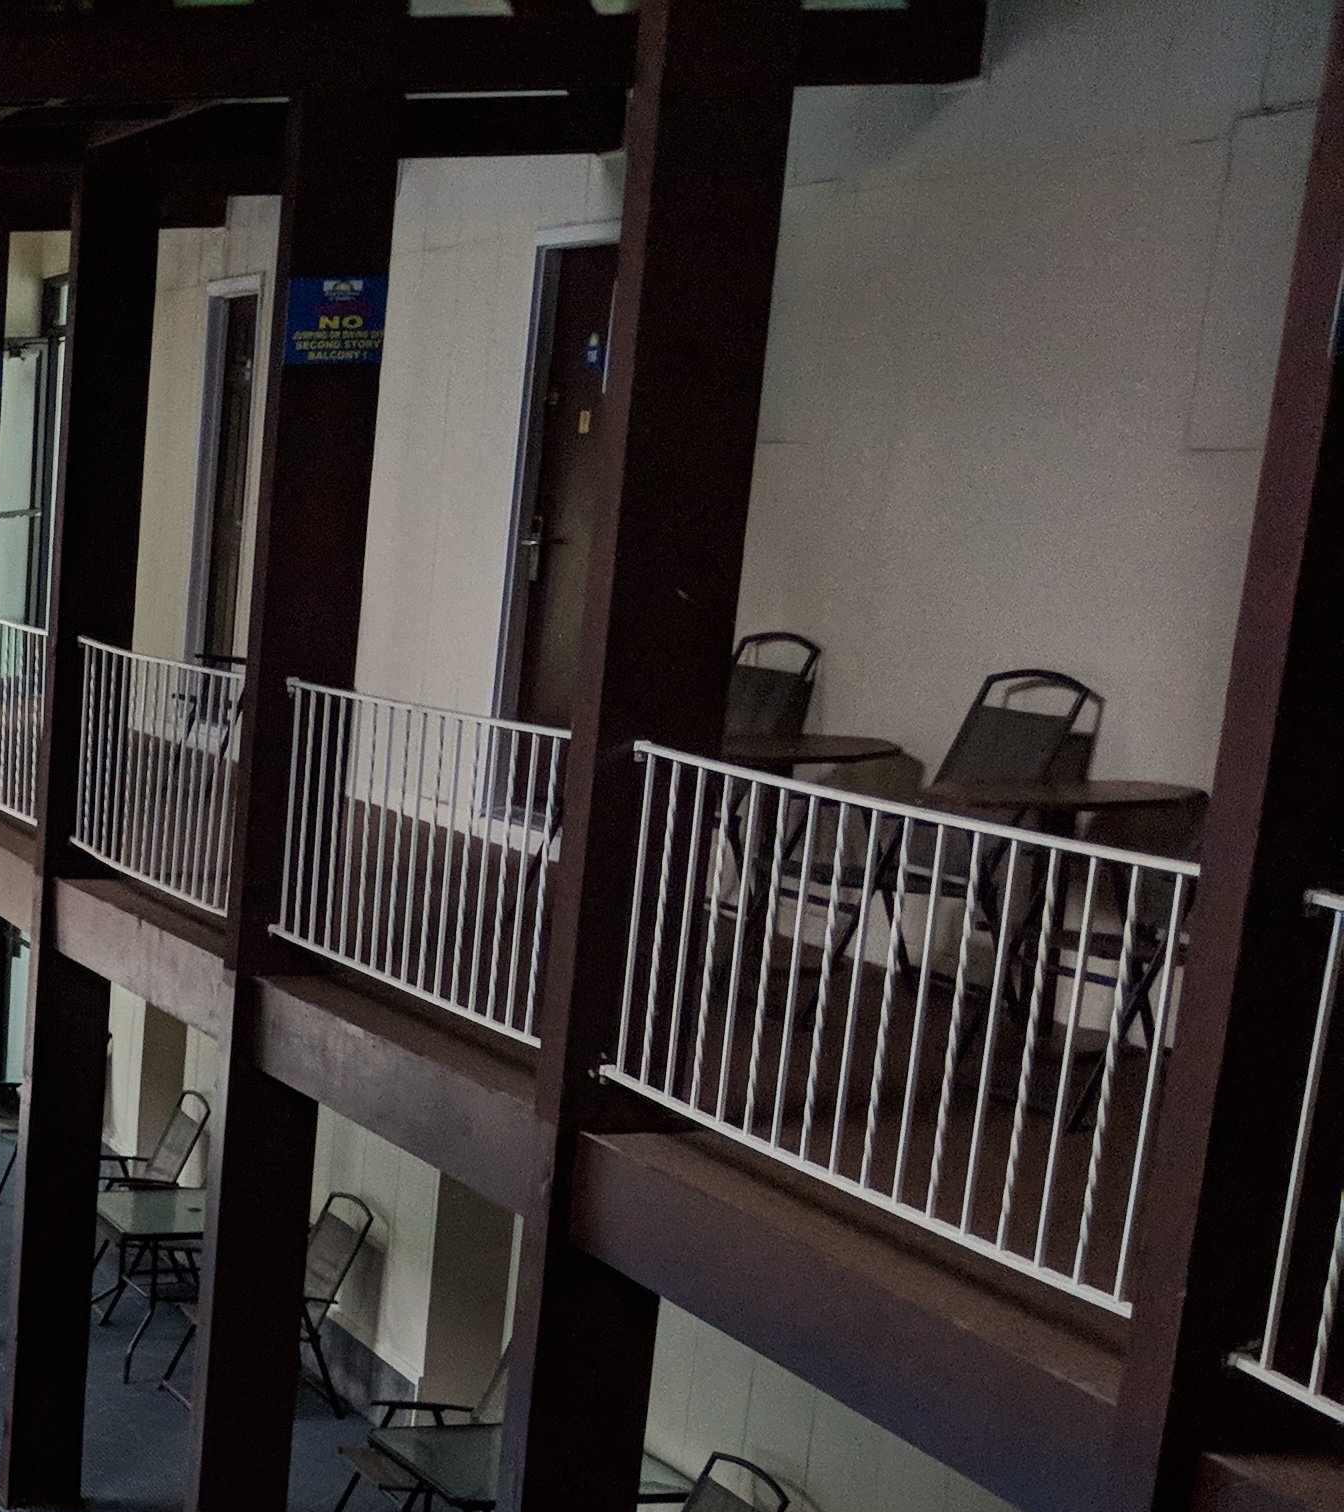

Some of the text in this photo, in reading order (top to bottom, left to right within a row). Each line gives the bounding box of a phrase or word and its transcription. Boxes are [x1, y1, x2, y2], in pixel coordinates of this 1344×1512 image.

[318, 314, 364, 330] NO
[295, 339, 381, 350] SECOND STORY
